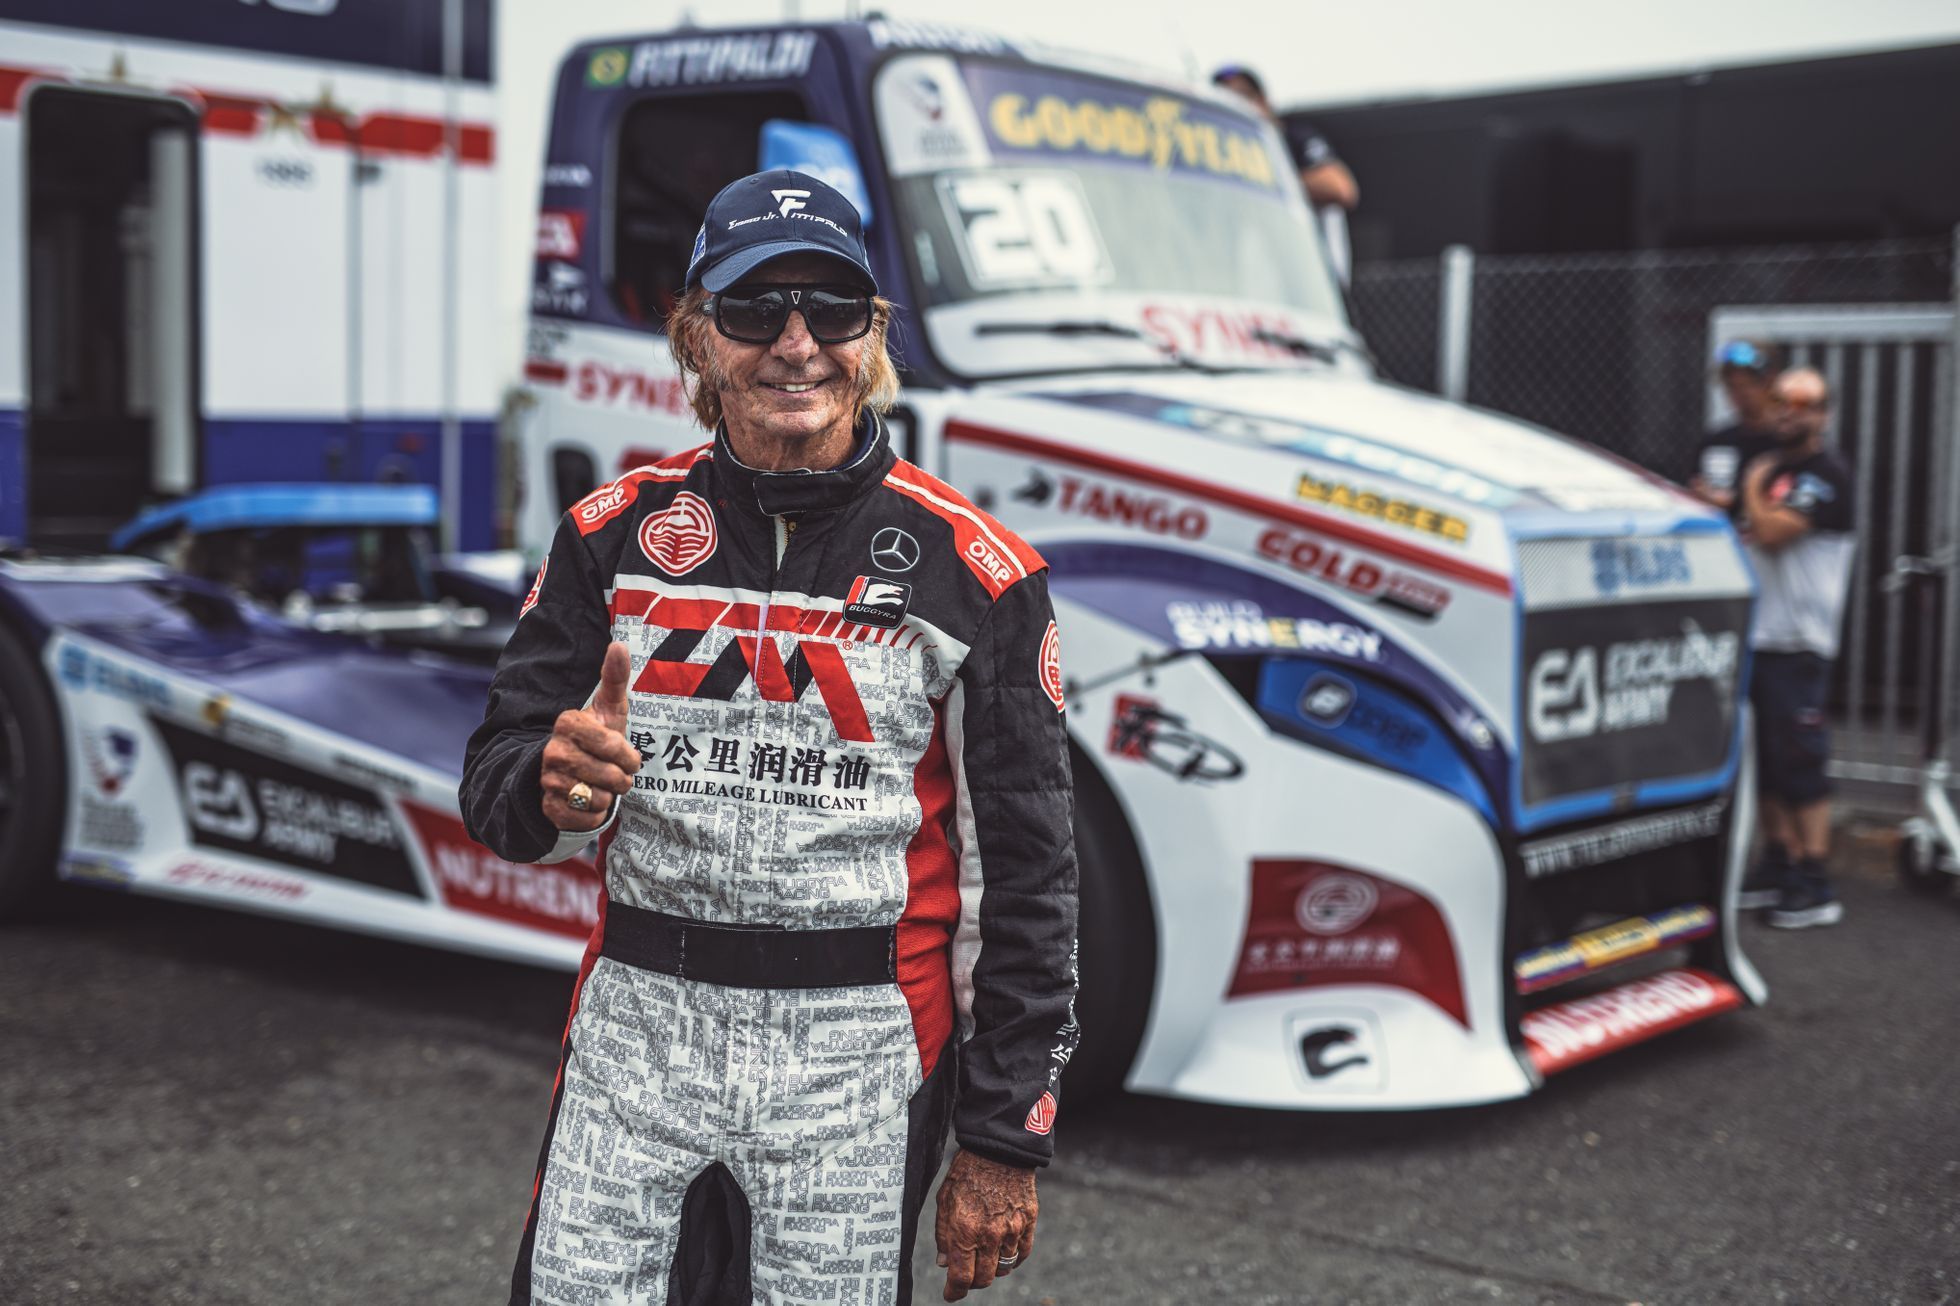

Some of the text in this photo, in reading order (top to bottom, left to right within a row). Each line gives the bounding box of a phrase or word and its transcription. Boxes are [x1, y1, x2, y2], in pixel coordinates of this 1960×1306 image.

[951, 175, 1103, 282] 20
[581, 489, 625, 520] OMP
[1053, 477, 1211, 541] TANGO
[969, 541, 1011, 582] OMP
[1256, 523, 1383, 593] COLD
[849, 603, 897, 621] BUGGYRA
[1174, 617, 1383, 662] SYNERGY
[630, 775, 868, 811] ERO MILEAGE LUBRICANT
[773, 876, 848, 889] BUGGYRA
[773, 887, 831, 900] RACING
[789, 1070, 863, 1086] BUGGYRA
[812, 1192, 887, 1203] BUGGYRA
[812, 1203, 870, 1214] RACING
